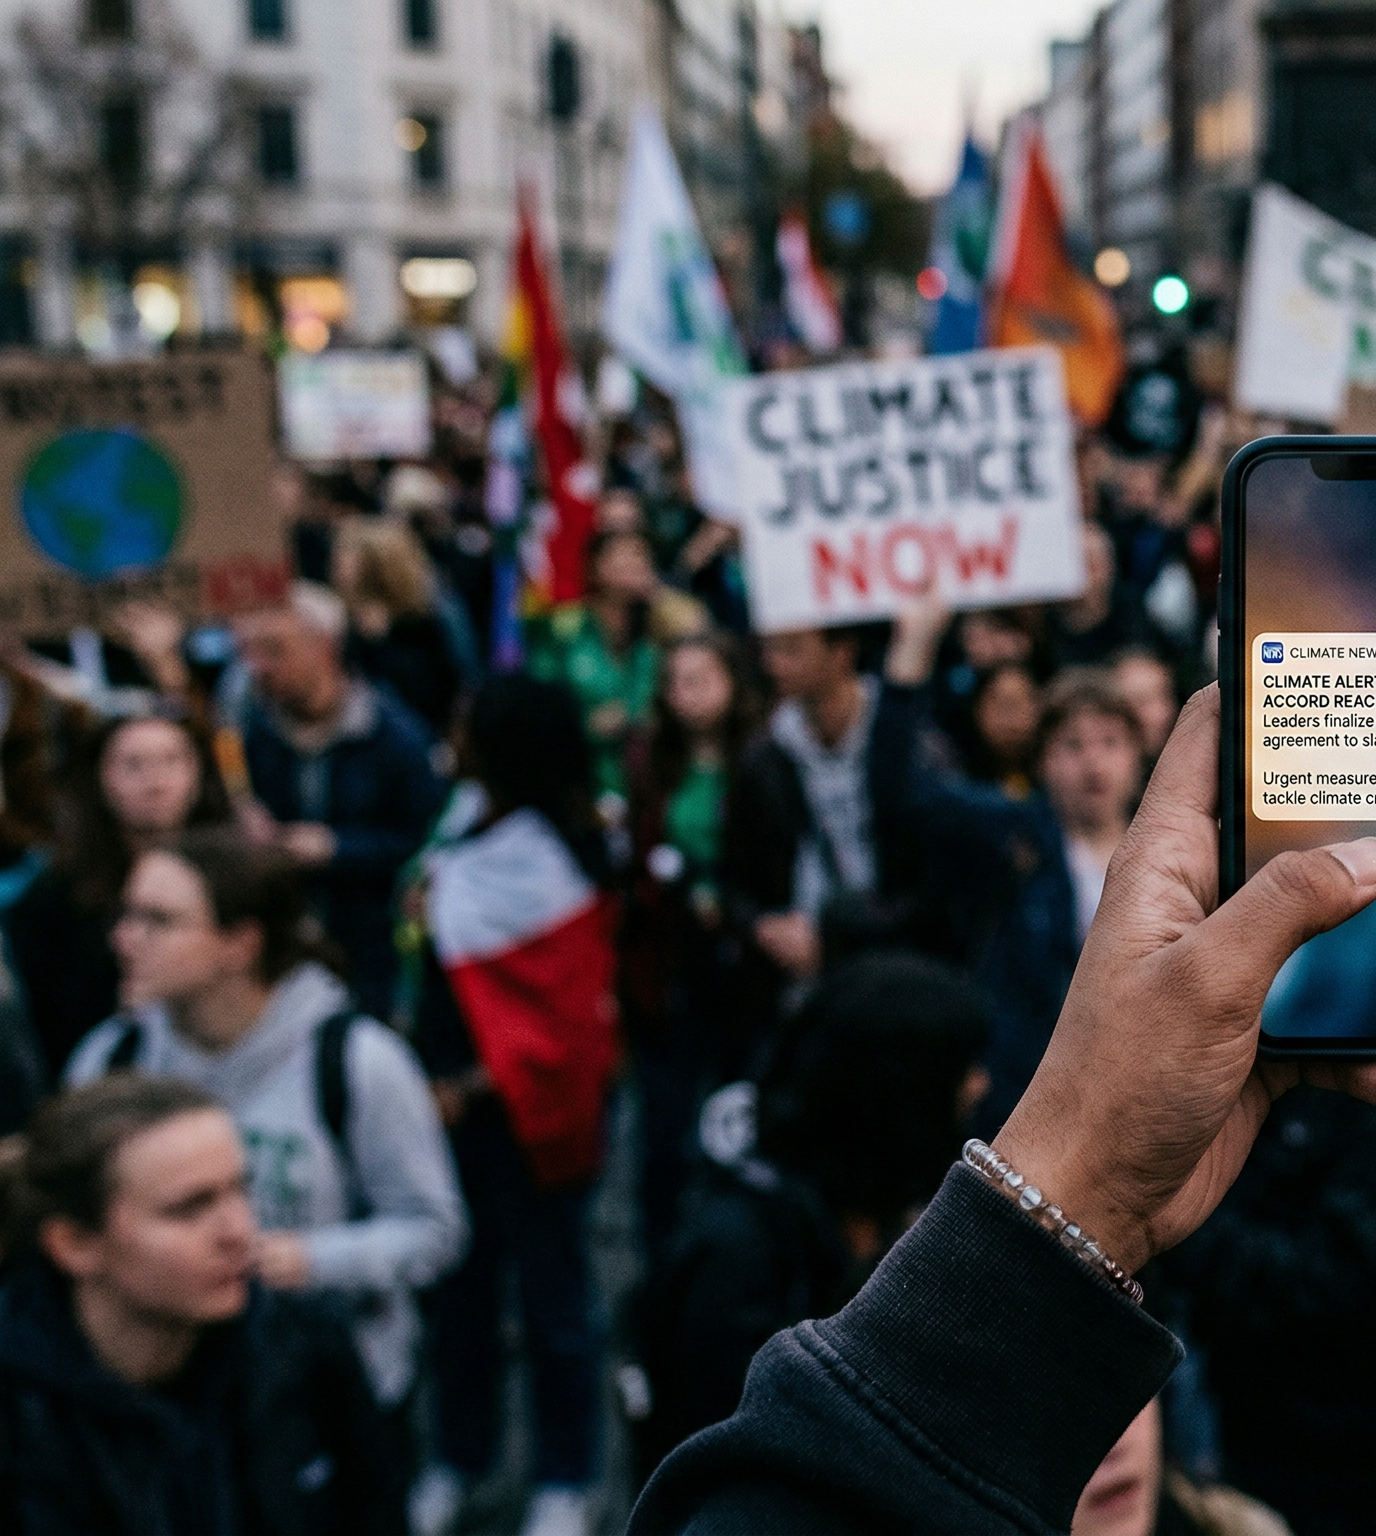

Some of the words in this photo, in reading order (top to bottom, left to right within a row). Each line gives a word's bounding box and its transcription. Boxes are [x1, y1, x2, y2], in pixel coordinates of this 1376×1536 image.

[745, 360, 1045, 452] CLIMATE
[762, 438, 1048, 527] JUSTICE
[810, 516, 1020, 605] NOW
[1289, 647, 1345, 659] CLIMATE
[1263, 675, 1331, 688] CLIMATE
[1263, 695, 1330, 708] ACCORD
[1263, 714, 1320, 728] Leaders
[1324, 714, 1374, 728] finalize
[1263, 735, 1340, 751] agreement
[1344, 735, 1359, 747] to
[1263, 772, 1312, 789] Urgent
[1263, 791, 1306, 805] tackle
[1310, 790, 1361, 805] climate
